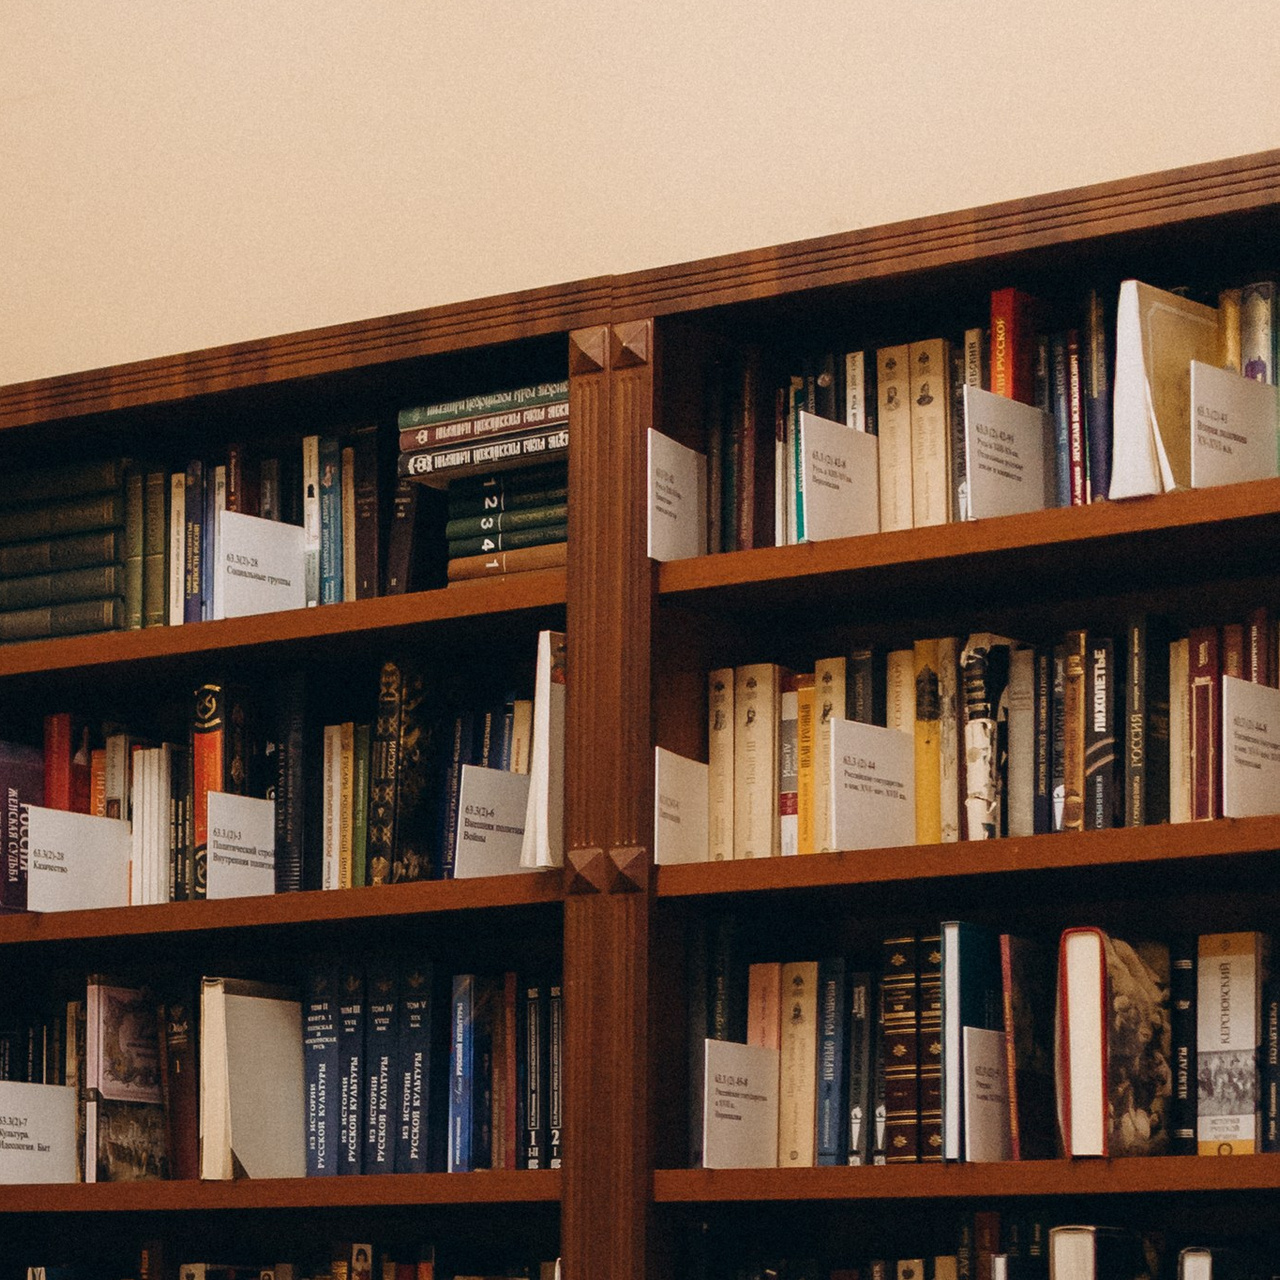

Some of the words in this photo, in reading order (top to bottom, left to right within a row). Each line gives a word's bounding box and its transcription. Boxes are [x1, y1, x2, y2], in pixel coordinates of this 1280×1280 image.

[995, 318, 1007, 371] РУССКОЙ
[1069, 354, 1081, 422] ВСЕВОЛОДОВИЧ
[1071, 422, 1082, 462] ЯРОСЛАВ
[485, 496, 498, 510] 2
[192, 523, 200, 553] РОССИИ
[480, 517, 494, 530] 3
[482, 538, 495, 551] 4
[486, 559, 499, 569] 1
[192, 555, 200, 594] КРЕПОСТИ
[226, 565, 267, 582] Социальные
[267, 575, 292, 587] группы
[1093, 649, 1107, 732] ЛИХОЛЕТЬЕ
[800, 703, 811, 743] ГРОЗНЫЙ
[1130, 713, 1143, 768] РОССИЯ
[342, 756, 350, 790] ГУСАРЫ
[387, 740, 397, 779] РОССИИ
[782, 754, 791, 777] Иван
[800, 745, 811, 769] ИВАН
[8, 787, 19, 839] ЖЕНСКАЯ
[96, 771, 106, 816] ОССИИ
[342, 795, 350, 852] РОССИЙСКОЙ
[463, 830, 486, 843] Войны
[464, 818, 494, 832] Внешняя
[8, 841, 19, 882] СУДЬБА
[33, 860, 69, 874] Казачество
[212, 839, 256, 856] Политический
[212, 852, 249, 868] Внутренняя
[371, 1005, 385, 1013] ТОМ
[386, 1003, 394, 1012] IV
[406, 1001, 420, 1010] ТОМ
[420, 1000, 427, 1009] V
[455, 1002, 464, 1042] КУЛЬТУРЫ
[1219, 962, 1231, 1045] КЕРСНОВСКИЙ
[455, 1043, 464, 1076] РУССКОЙ
[1176, 1046, 1188, 1100] МЕМУАРЫ
[317, 1063, 326, 1117] КУЛЬТУРЫ
[348, 1056, 358, 1111] КУЛЬТУРЫ
[377, 1056, 388, 1110] КУЛЬТУРЫ
[402, 1072, 410, 1122] ИСТОРИИ
[410, 1052, 422, 1107] КУЛЬТУРЫ
[341, 1077, 349, 1126] ИСТОРИИ
[369, 1076, 378, 1125] ИСТОРИИ
[37, 1142, 51, 1153] Быт
[310, 1137, 316, 1150] ИЗ
[317, 1121, 325, 1169] РУССКОЙ
[341, 1130, 349, 1143] ИЗ
[348, 1114, 357, 1163] РУССКОЙ
[369, 1129, 378, 1143] ИЗ
[377, 1114, 387, 1162] РУССКОЙ
[402, 1126, 410, 1140] ИЗ
[410, 1110, 421, 1159] РУССКОЙ
[530, 1131, 537, 1146] 1
[551, 1130, 560, 1146] 2
[959, 1247, 970, 1277] XVIII
